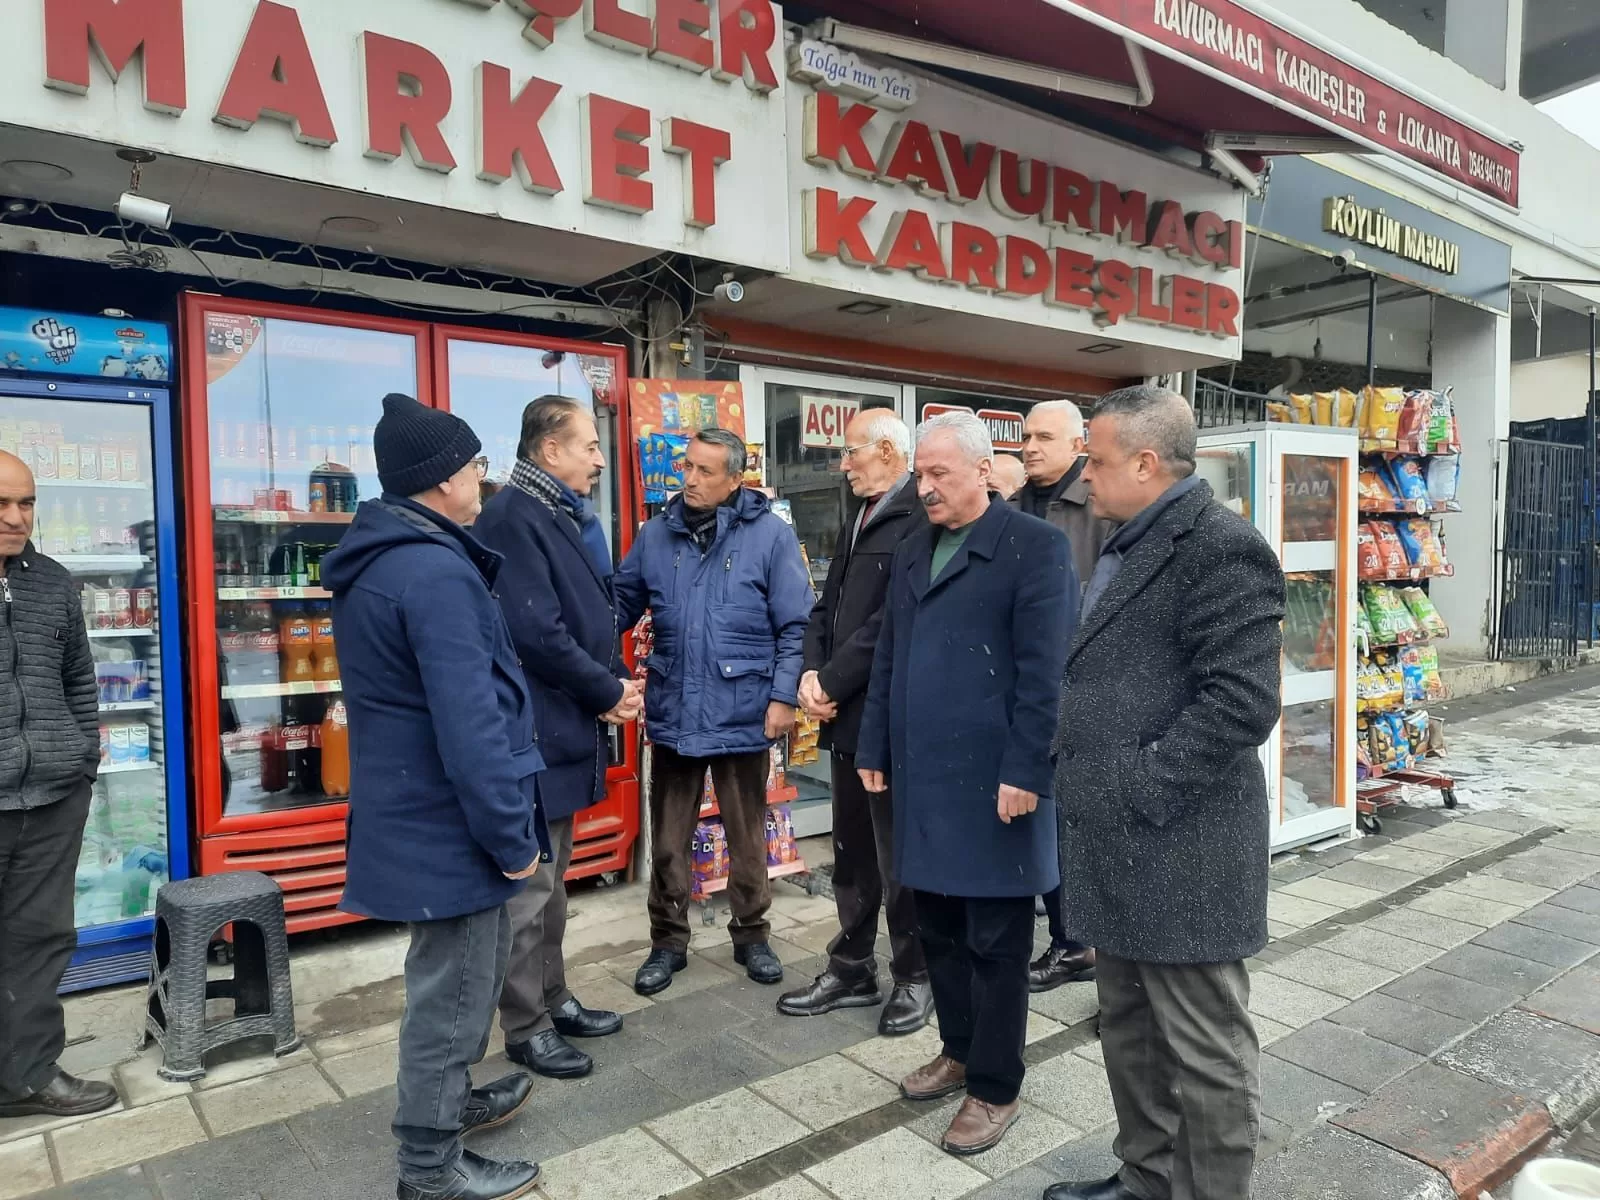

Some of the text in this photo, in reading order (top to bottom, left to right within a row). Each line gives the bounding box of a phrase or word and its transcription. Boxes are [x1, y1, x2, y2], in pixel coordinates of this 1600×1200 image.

[45, 0, 731, 228] MARKET
[804, 47, 911, 100] Tolga'nın Yeri
[1154, 0, 1263, 74] KAVURMACI
[1276, 48, 1366, 124] KARDEŞLER
[1377, 110, 1387, 135] &
[1398, 112, 1461, 170] LOKANTA
[810, 91, 1241, 271] KAVURMACI
[1327, 194, 1400, 254] KÖYLÜM
[808, 187, 1239, 336] KARDEŞLER
[805, 403, 857, 445] AÇIK
[318, 626, 333, 636] FAN
